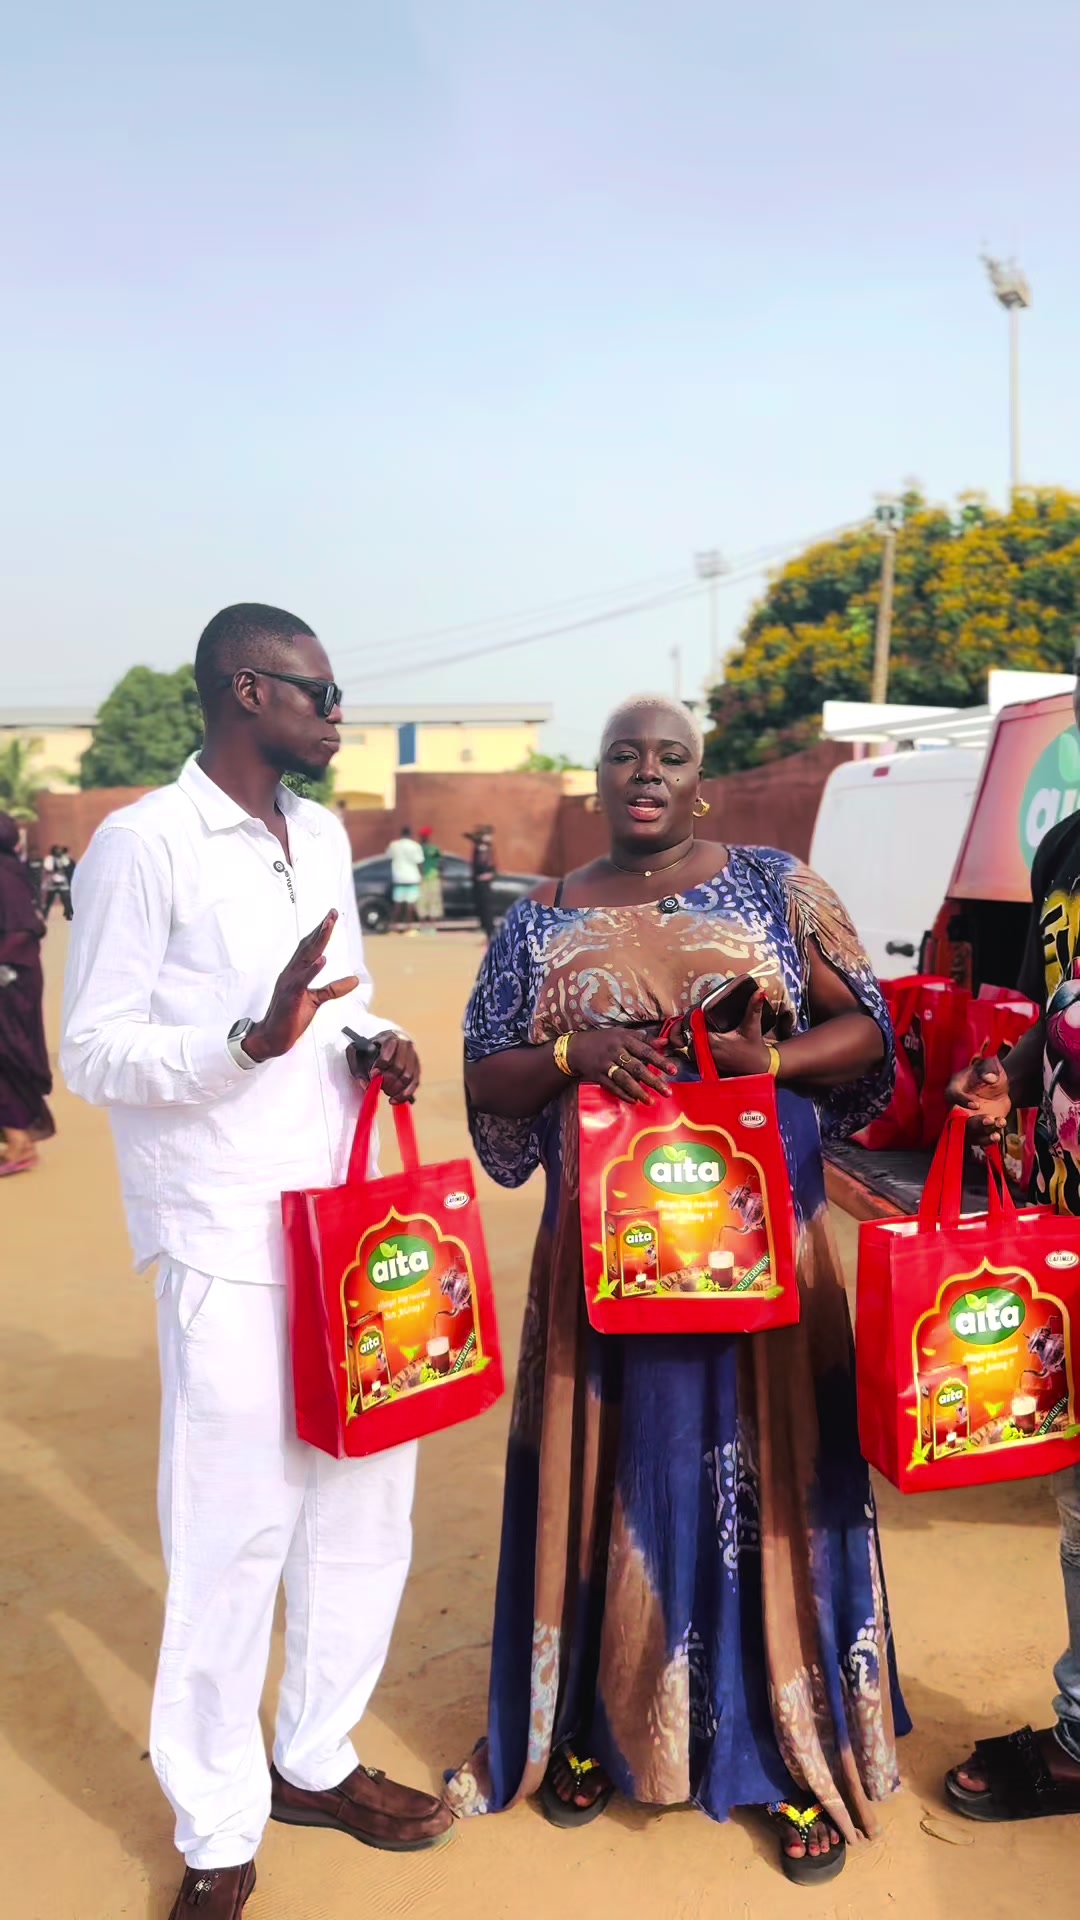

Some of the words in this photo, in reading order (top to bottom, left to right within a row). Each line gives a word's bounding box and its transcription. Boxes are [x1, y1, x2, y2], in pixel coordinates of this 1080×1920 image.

[650, 1156, 720, 1183] aita
[625, 1231, 652, 1244] aita
[372, 1250, 429, 1284] aita
[955, 1302, 1020, 1336] aita
[359, 1335, 380, 1354] aita
[938, 1389, 963, 1405] aita
